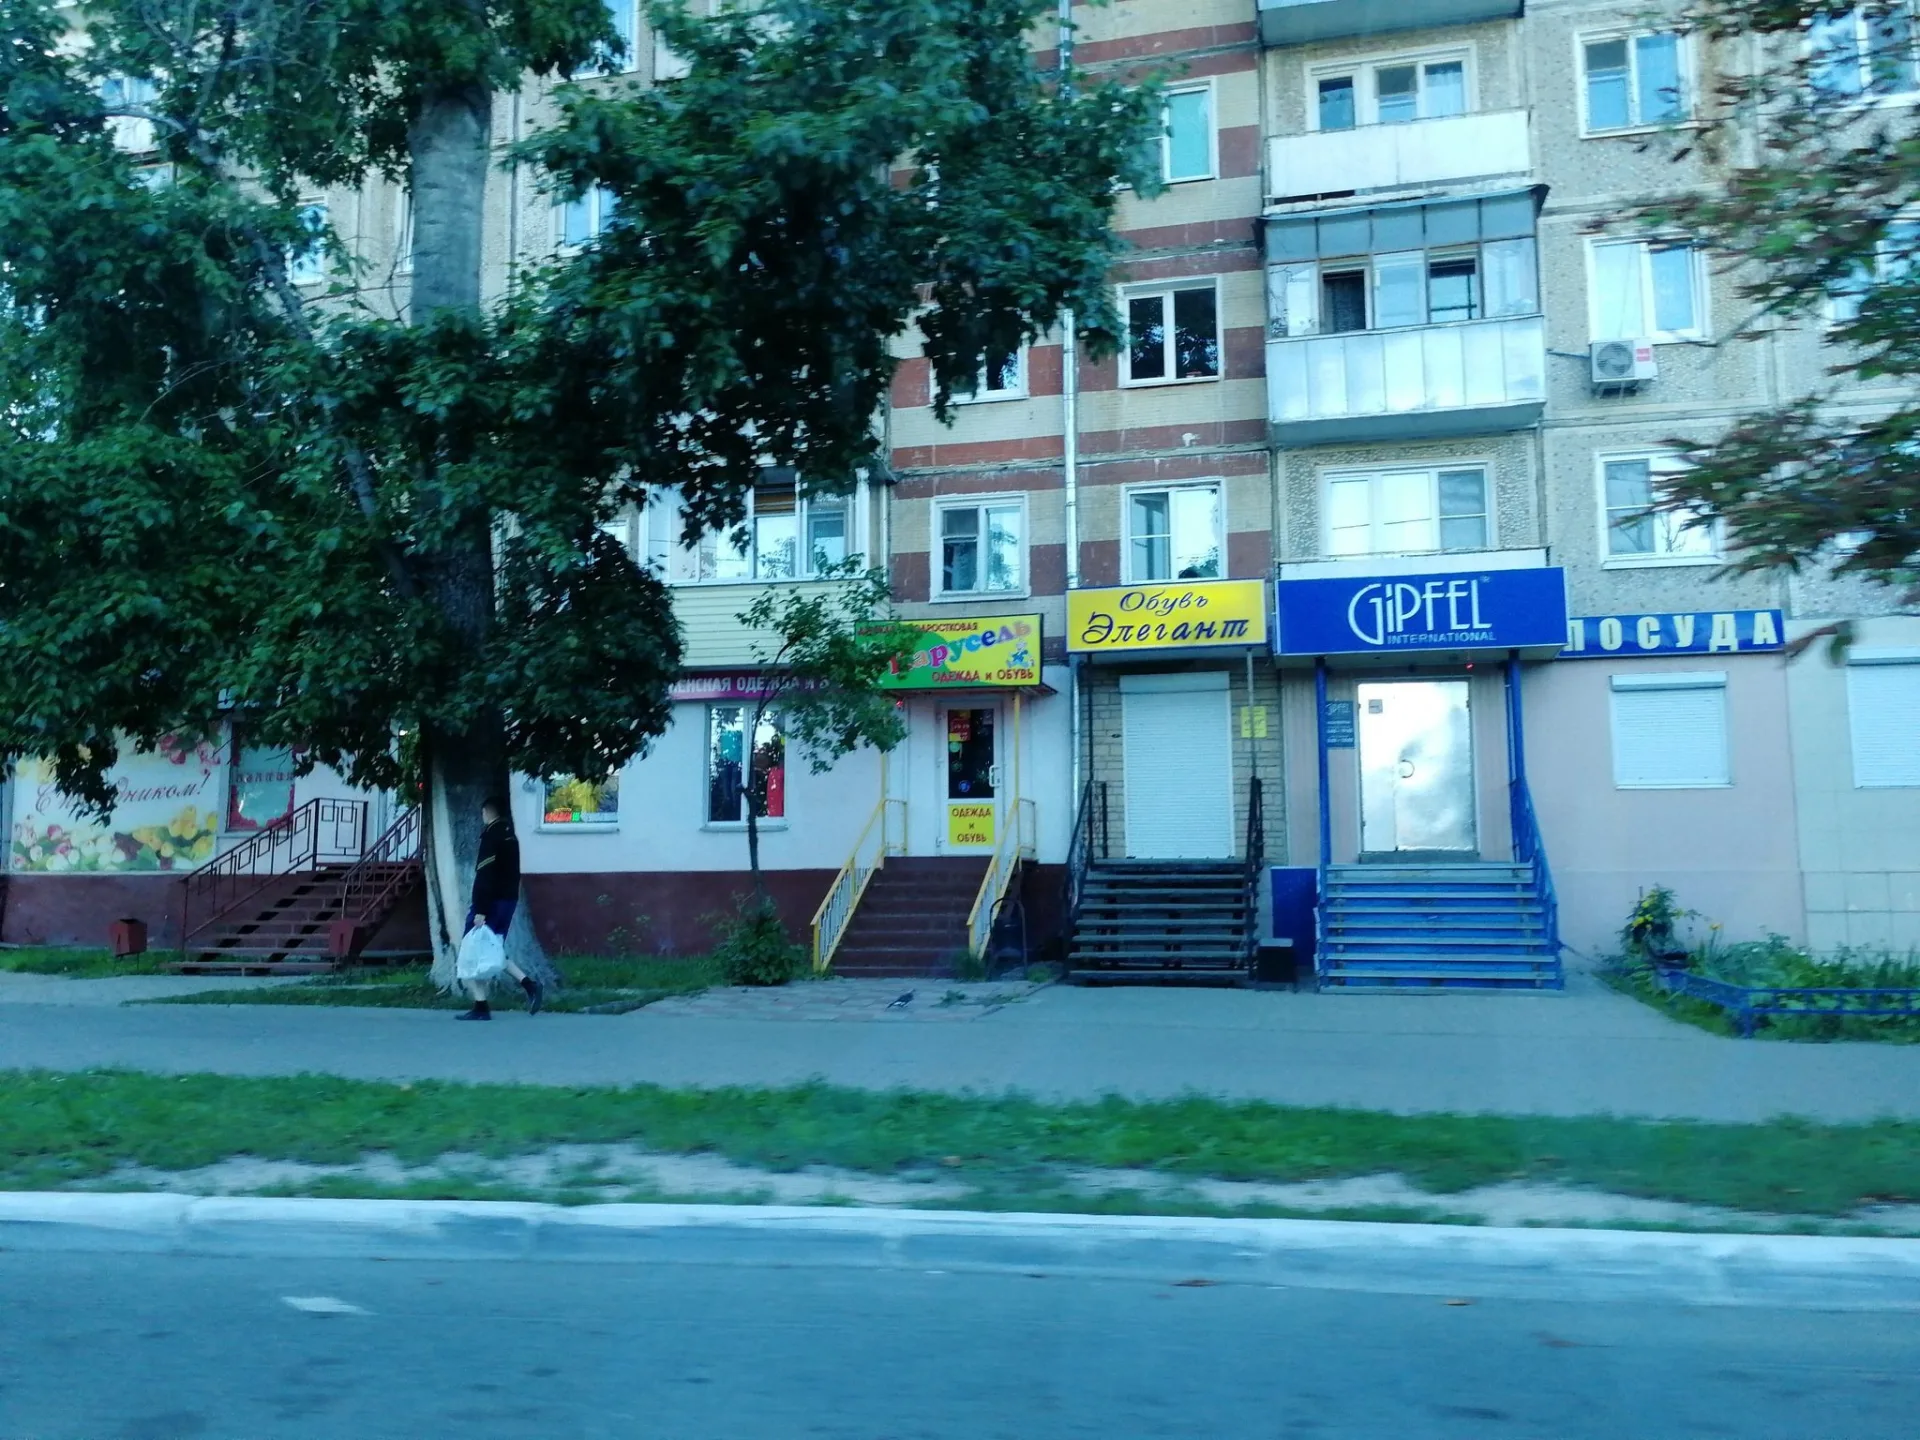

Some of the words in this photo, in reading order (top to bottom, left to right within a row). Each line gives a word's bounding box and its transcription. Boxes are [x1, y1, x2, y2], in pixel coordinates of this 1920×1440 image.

[1081, 611, 1249, 644] Элегант
[1565, 611, 1779, 652] ПОСУДА
[1387, 631, 1497, 645] INTERNATIONAL
[932, 669, 980, 682] ОДЕЖДА
[997, 668, 1034, 681] ОБУВЬ
[951, 807, 992, 819] ОДЕЖДА
[956, 832, 987, 843] ОБУВЬ
